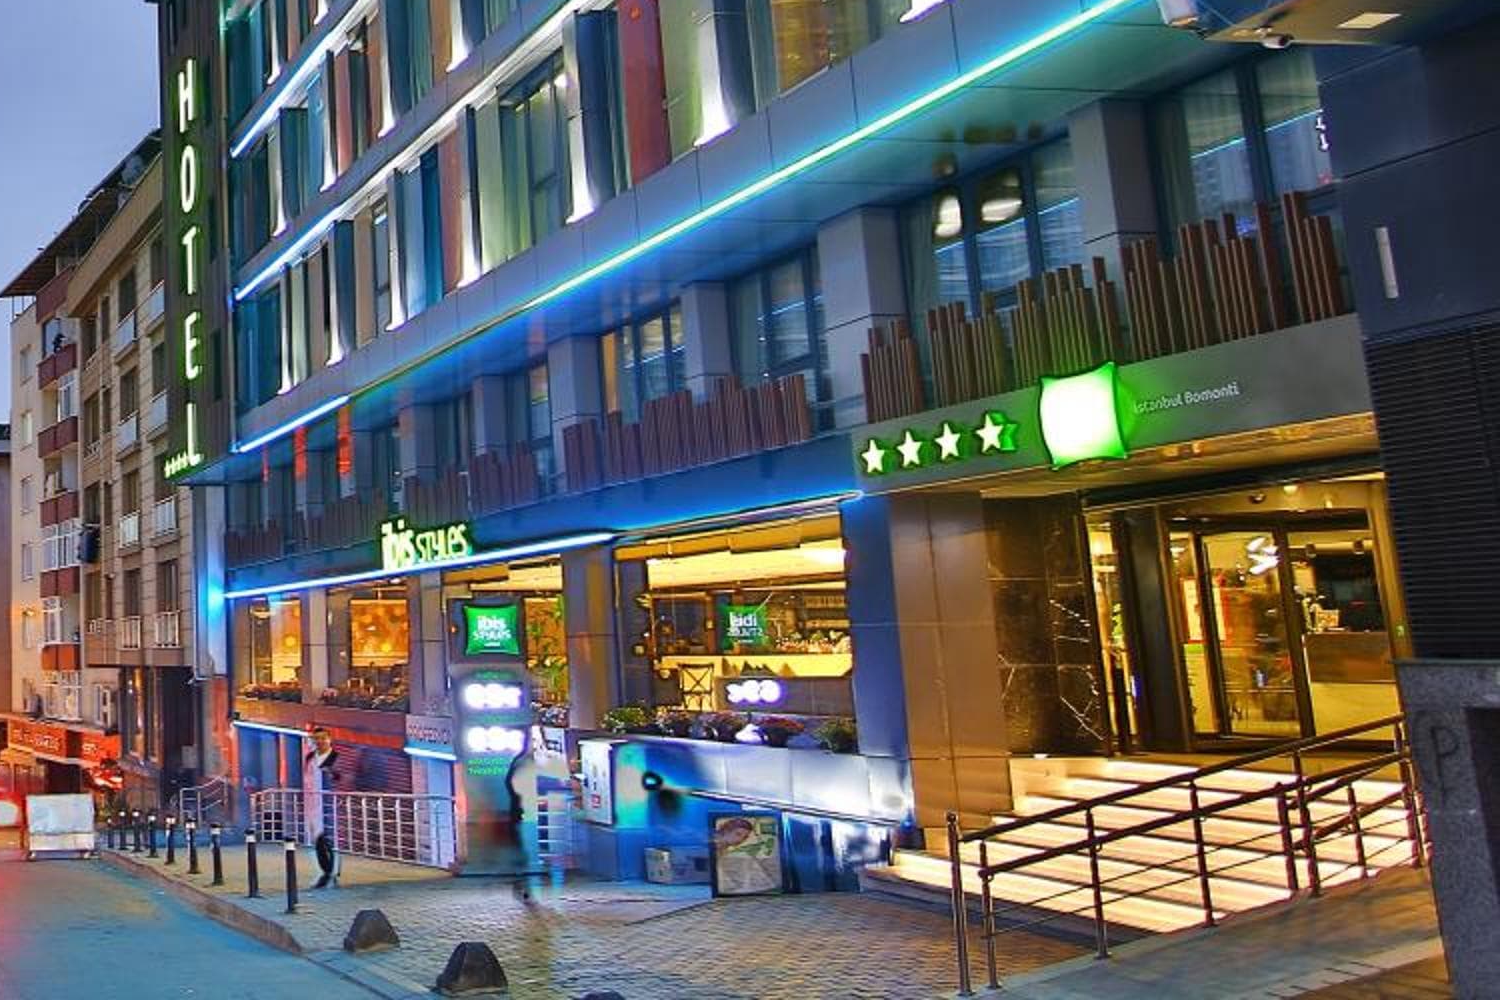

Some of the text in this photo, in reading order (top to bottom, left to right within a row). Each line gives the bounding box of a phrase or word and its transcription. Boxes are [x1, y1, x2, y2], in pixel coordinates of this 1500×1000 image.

[177, 57, 203, 467] HOTEL
[1184, 382, 1239, 403] Bomonti
[381, 519, 415, 569] ibis
